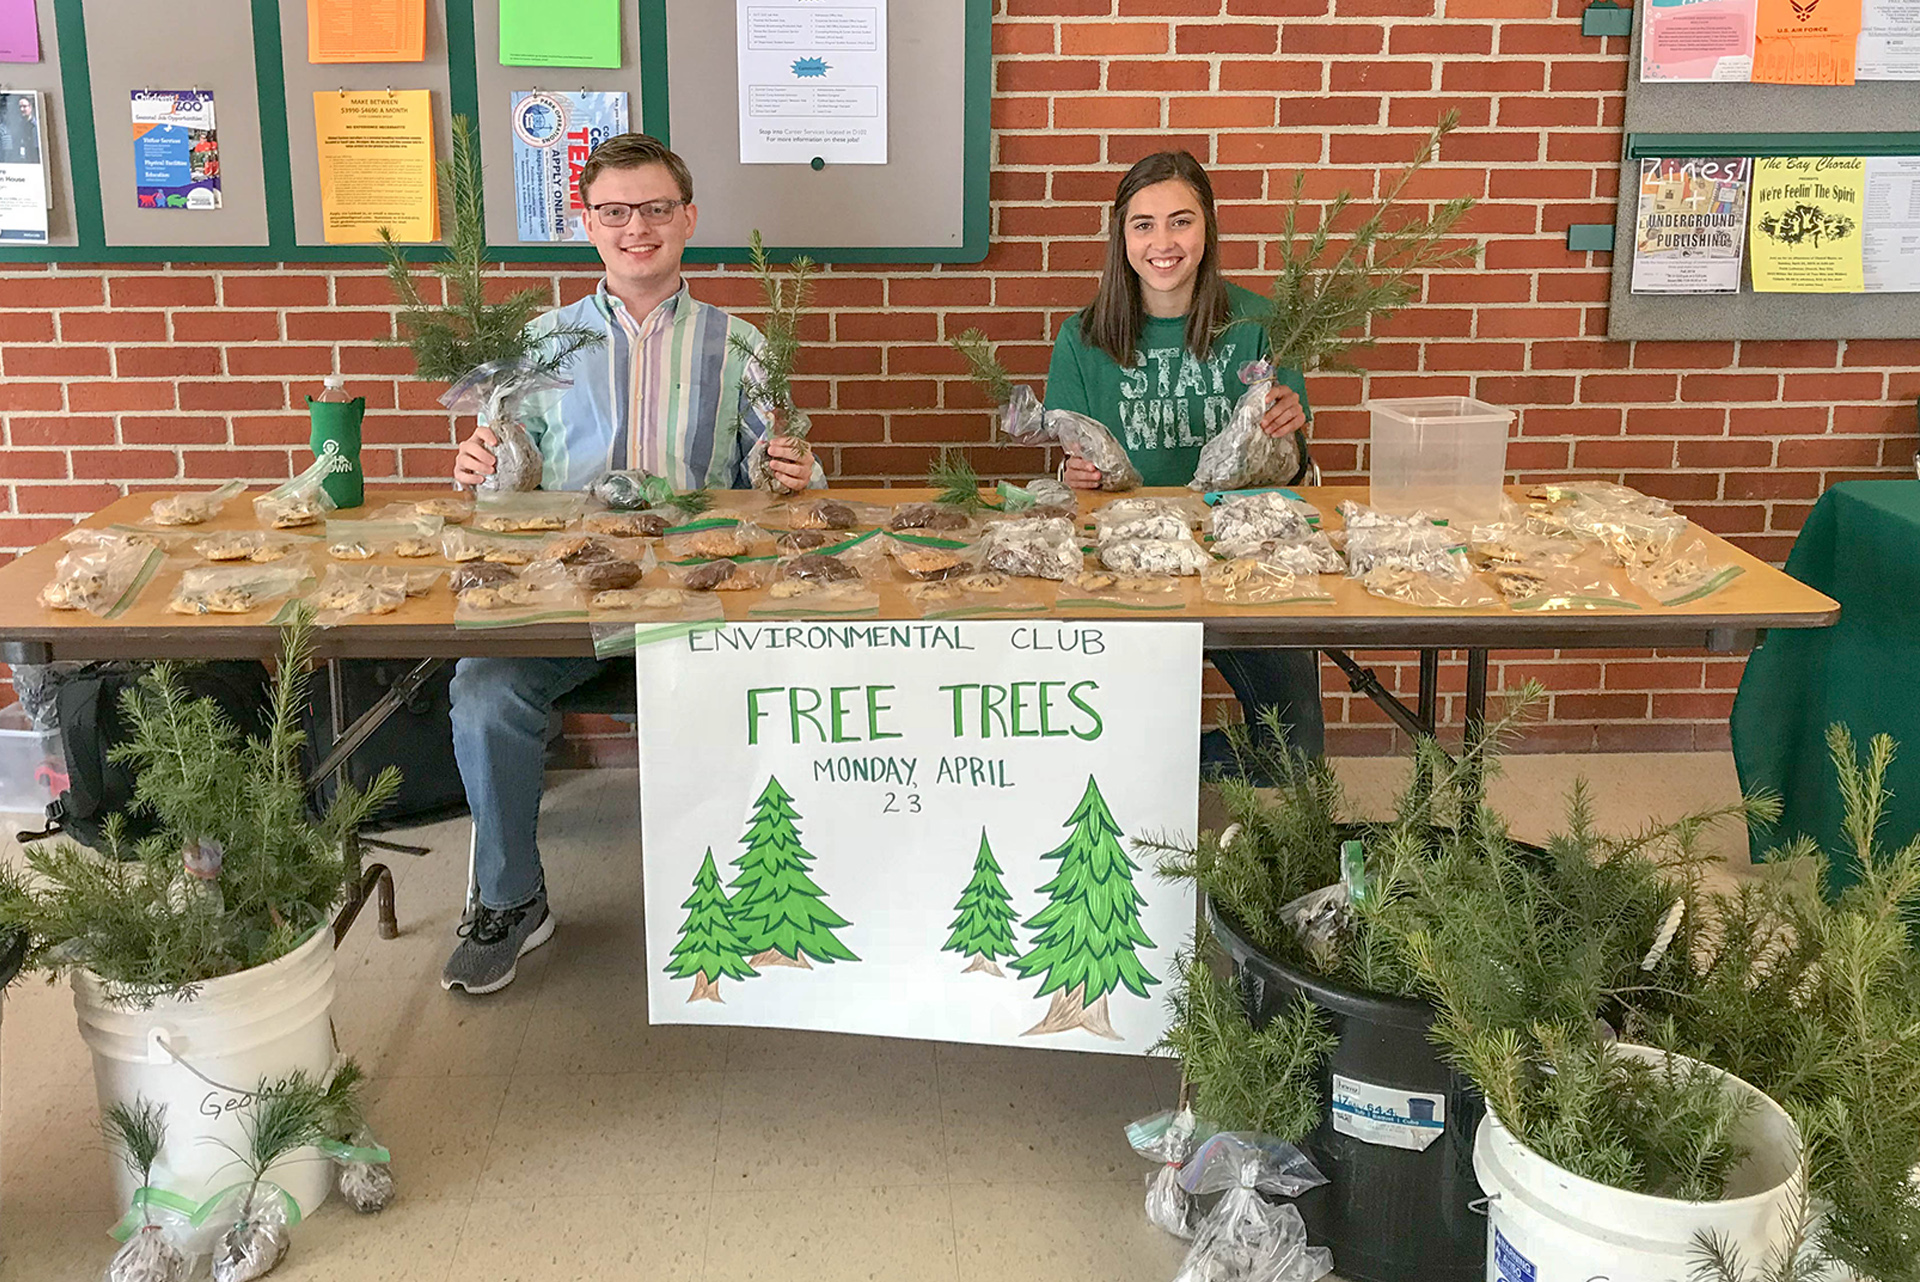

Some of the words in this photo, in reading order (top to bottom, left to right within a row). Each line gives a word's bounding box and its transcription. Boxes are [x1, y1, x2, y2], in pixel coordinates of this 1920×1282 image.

[540, 99, 556, 110] PARK
[542, 110, 562, 144] OPERATIONS
[552, 150, 561, 186] APPLY
[568, 126, 590, 210] TEAM
[1643, 157, 1746, 187] Zines!
[1760, 157, 1782, 170] The
[1786, 157, 1810, 172] Bay
[1815, 157, 1862, 172] Chorale
[1760, 186, 1782, 203] We're
[1784, 184, 1813, 199] Feelin'
[1814, 184, 1830, 199] The
[1832, 185, 1855, 204] Spirit
[554, 190, 564, 234] ONLINE
[1648, 214, 1735, 228] UNDERGROUND
[1656, 234, 1727, 247] PUBLISHING
[1119, 344, 1236, 399] STAY
[1118, 396, 1232, 450] WILD
[687, 623, 976, 654] ENVIRONMENTAL
[1010, 626, 1107, 656] CLUB
[746, 683, 905, 746] FREE
[938, 679, 1104, 742] TREES
[812, 754, 920, 789] MONDAY,
[935, 757, 1016, 789] APRIL
[882, 791, 923, 814] 23
[1338, 1094, 1349, 1105] 17
[1367, 1103, 1394, 1116] 64.4
